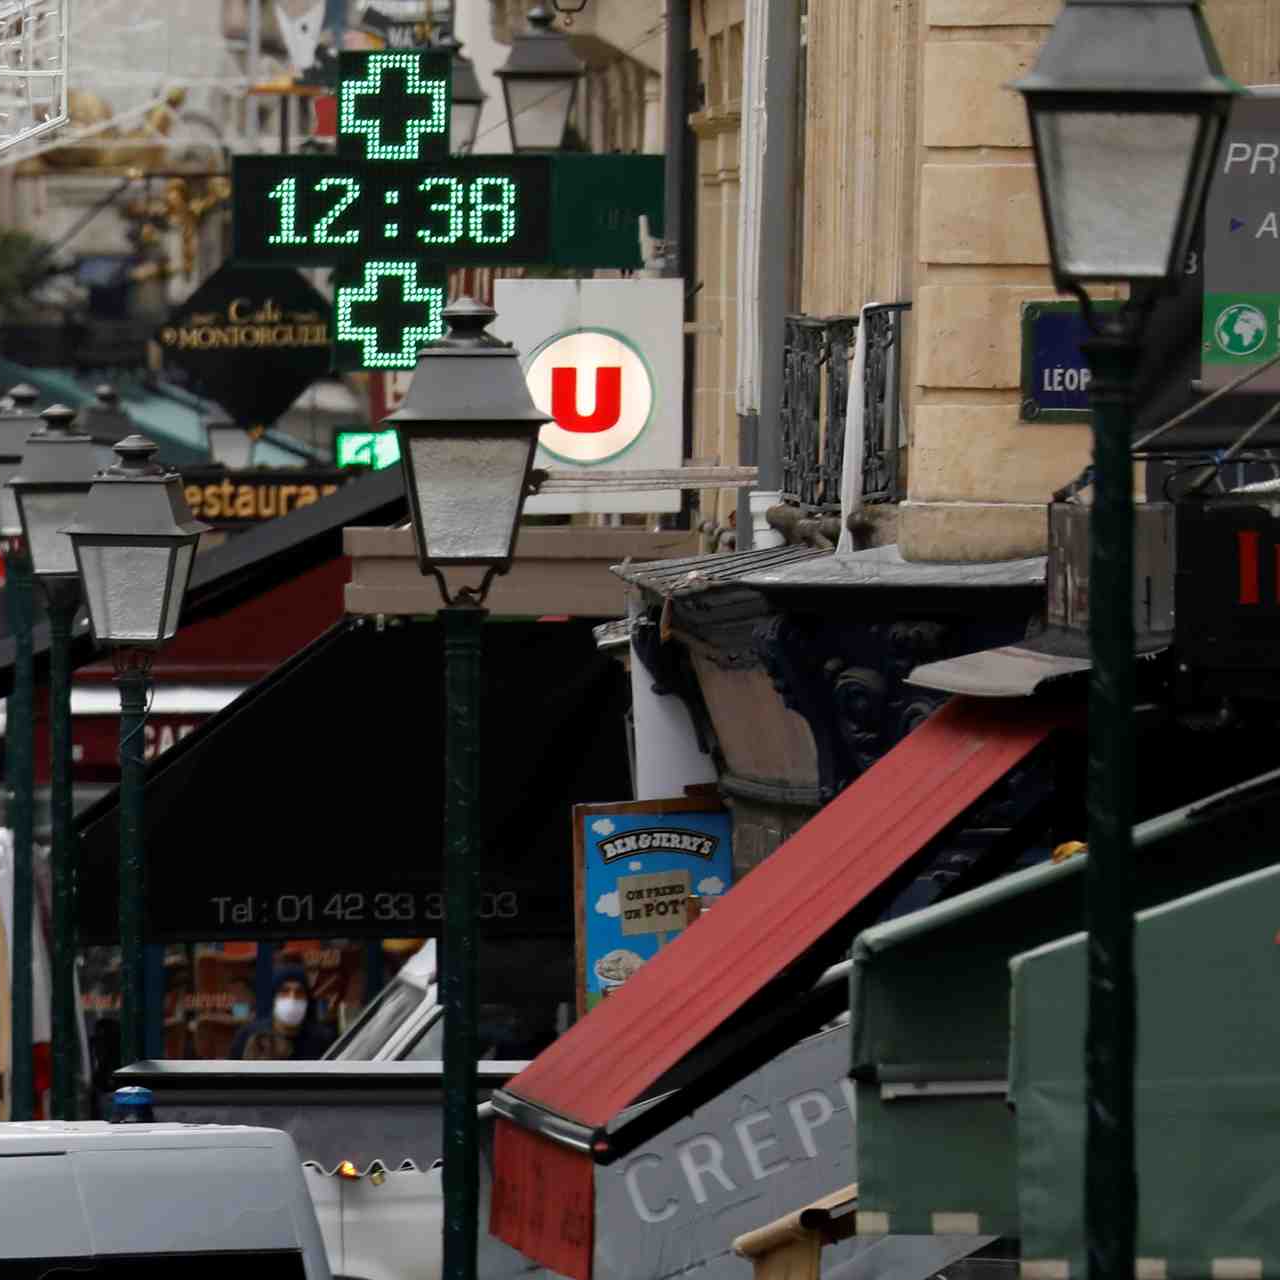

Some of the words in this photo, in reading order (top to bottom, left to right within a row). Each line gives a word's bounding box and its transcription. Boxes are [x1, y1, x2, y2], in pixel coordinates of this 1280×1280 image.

[1223, 142, 1280, 174] PR
[267, 176, 517, 245] 12:38
[552, 367, 622, 434] U
[1043, 363, 1093, 392] LÉOP
[323, 893, 364, 921] 42
[624, 1078, 857, 1224] CRÊP
